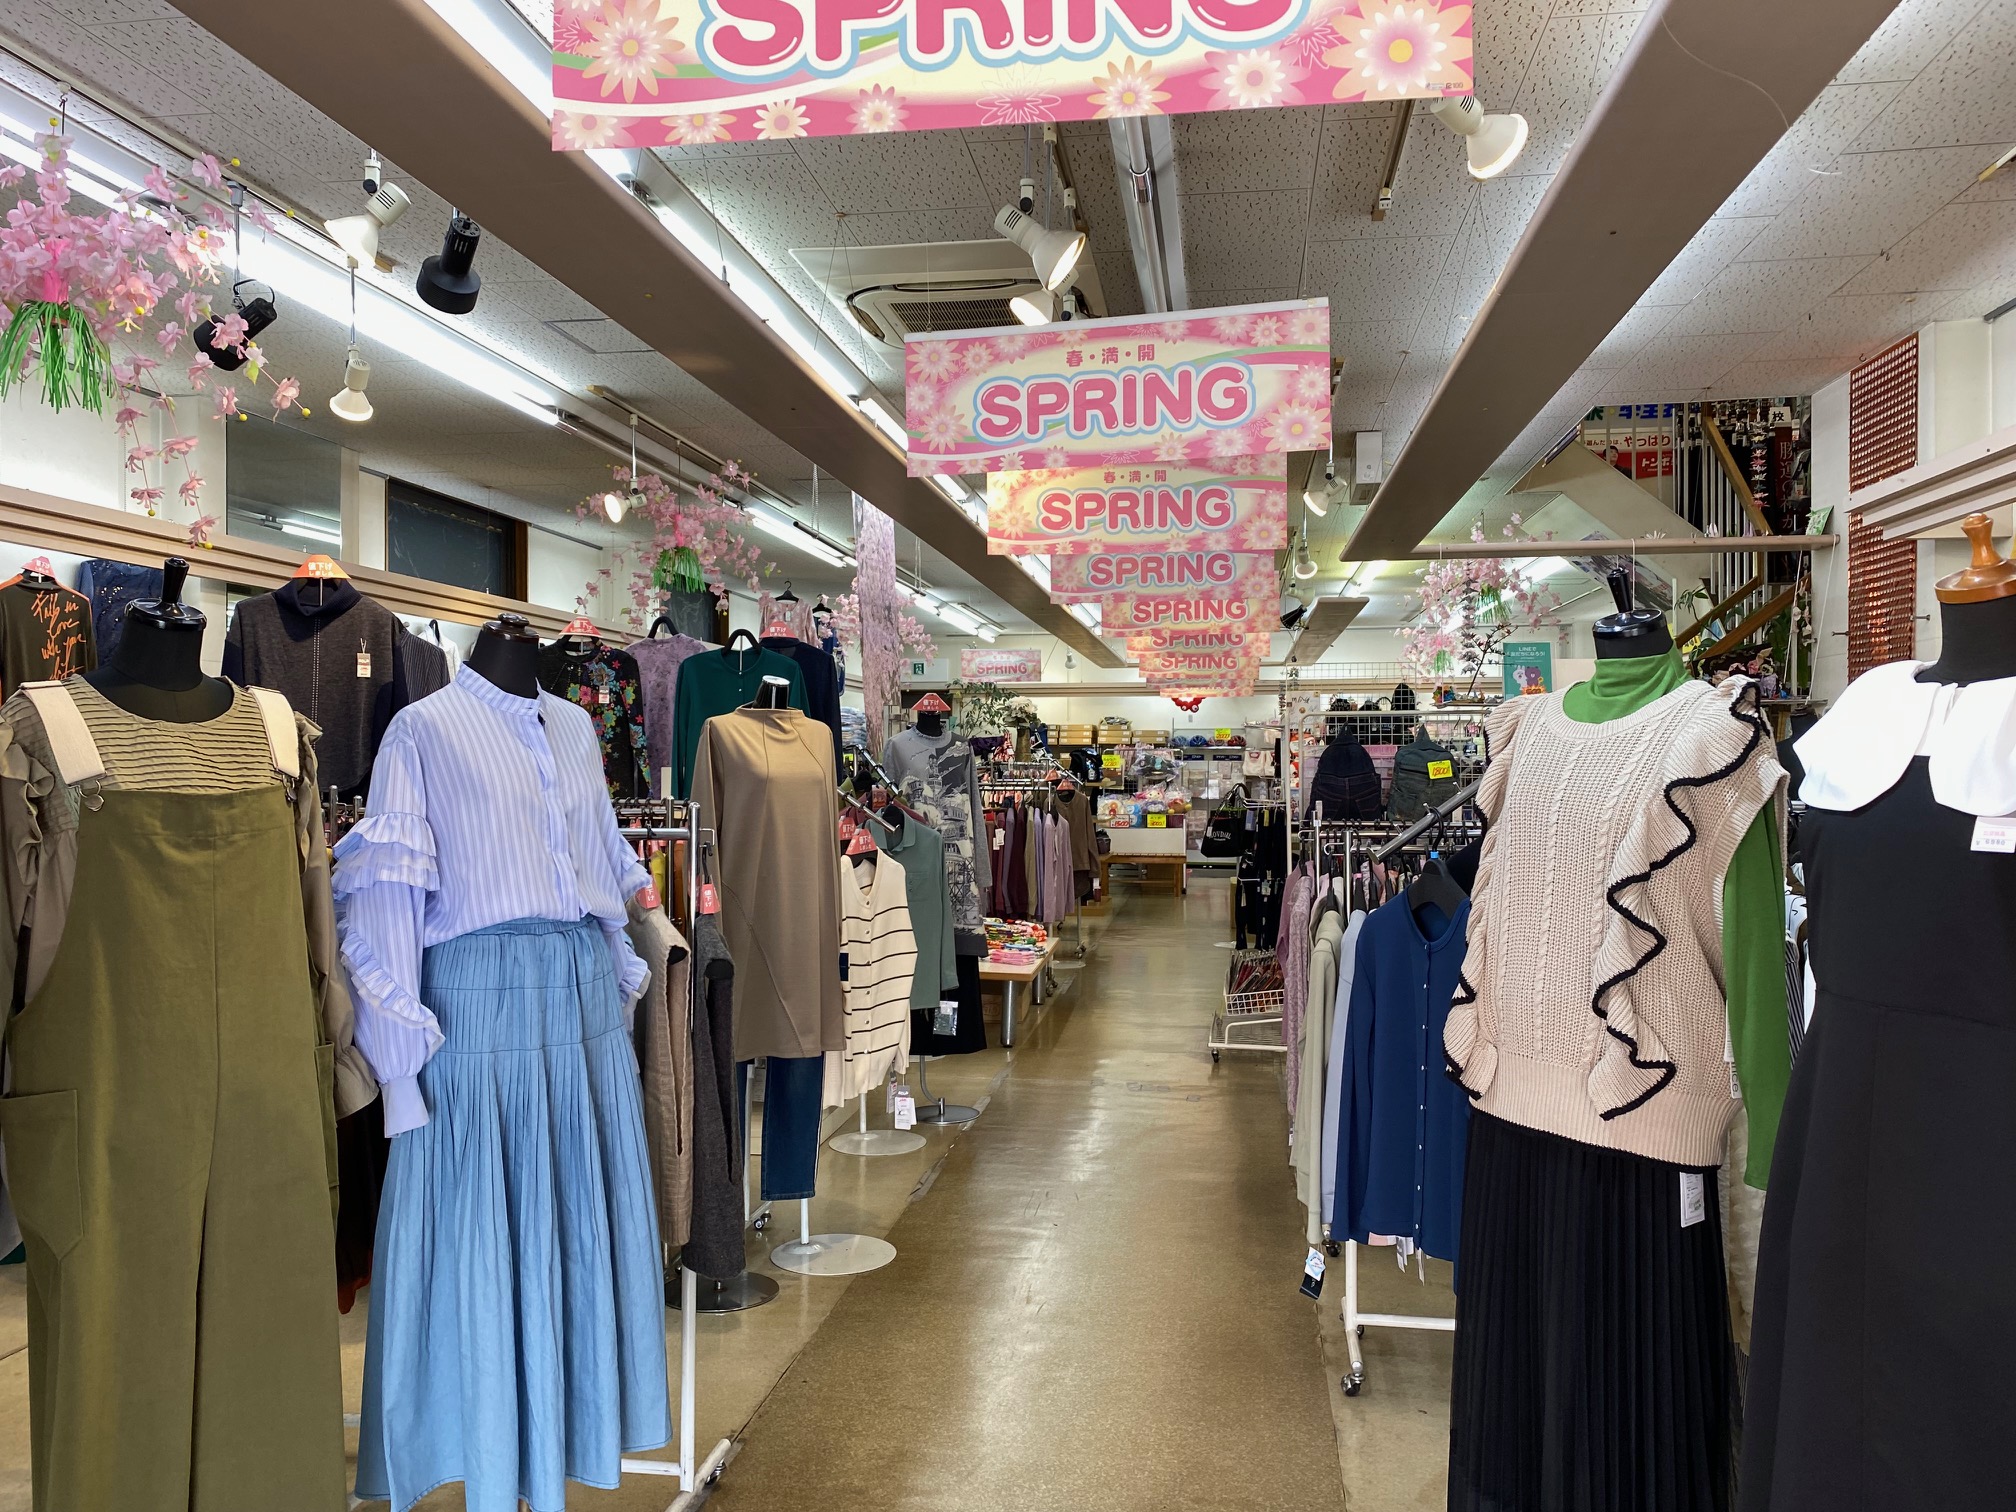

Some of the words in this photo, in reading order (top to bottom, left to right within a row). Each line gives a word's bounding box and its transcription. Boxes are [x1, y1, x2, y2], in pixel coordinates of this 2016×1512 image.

[1066, 344, 1156, 367] 春・満・開
[979, 366, 1248, 438] SPRING
[1041, 488, 1232, 532] SPRING
[307, 562, 332, 571] 値下げ
[1089, 552, 1233, 586] SPRING
[1132, 600, 1247, 622] SPRING
[1152, 633, 1244, 648] SPRING
[976, 662, 1027, 674] SPRING
[1161, 656, 1238, 670] SPRING
